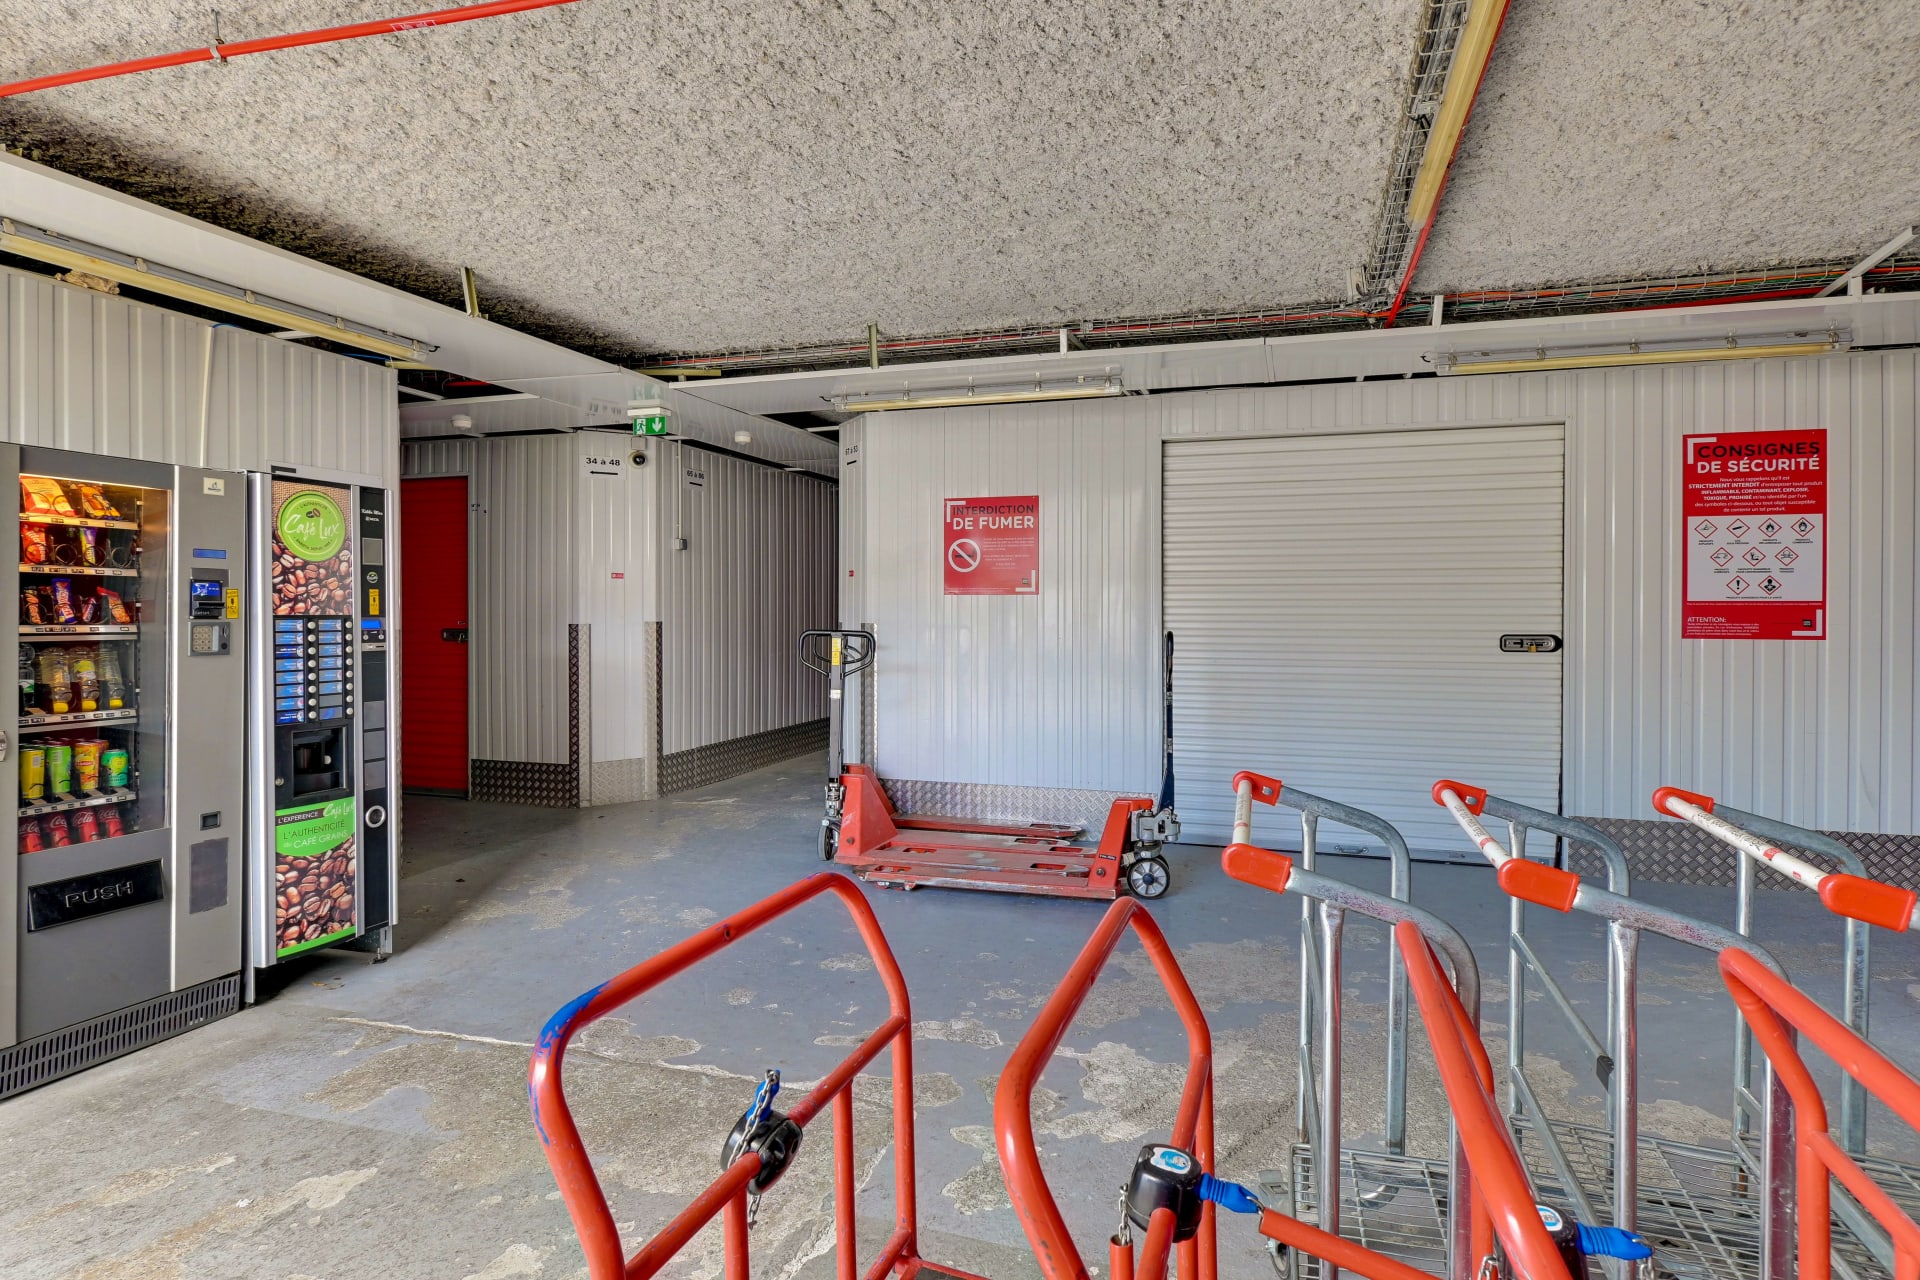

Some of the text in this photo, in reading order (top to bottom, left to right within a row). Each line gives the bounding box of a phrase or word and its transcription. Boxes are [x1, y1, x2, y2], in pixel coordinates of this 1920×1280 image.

[1698, 441, 1820, 458] CONSIGNES
[1697, 454, 1820, 474] DE SÉCURITÉ
[953, 505, 1034, 515] INTERDICTION
[284, 514, 340, 541] Café Lux
[953, 515, 1034, 530] DE FUMER
[323, 803, 341, 819] Café
[283, 819, 345, 840] L'AUTHENTICITÉ
[293, 836, 317, 848] CAFÉ
[65, 880, 134, 908] PUSH
